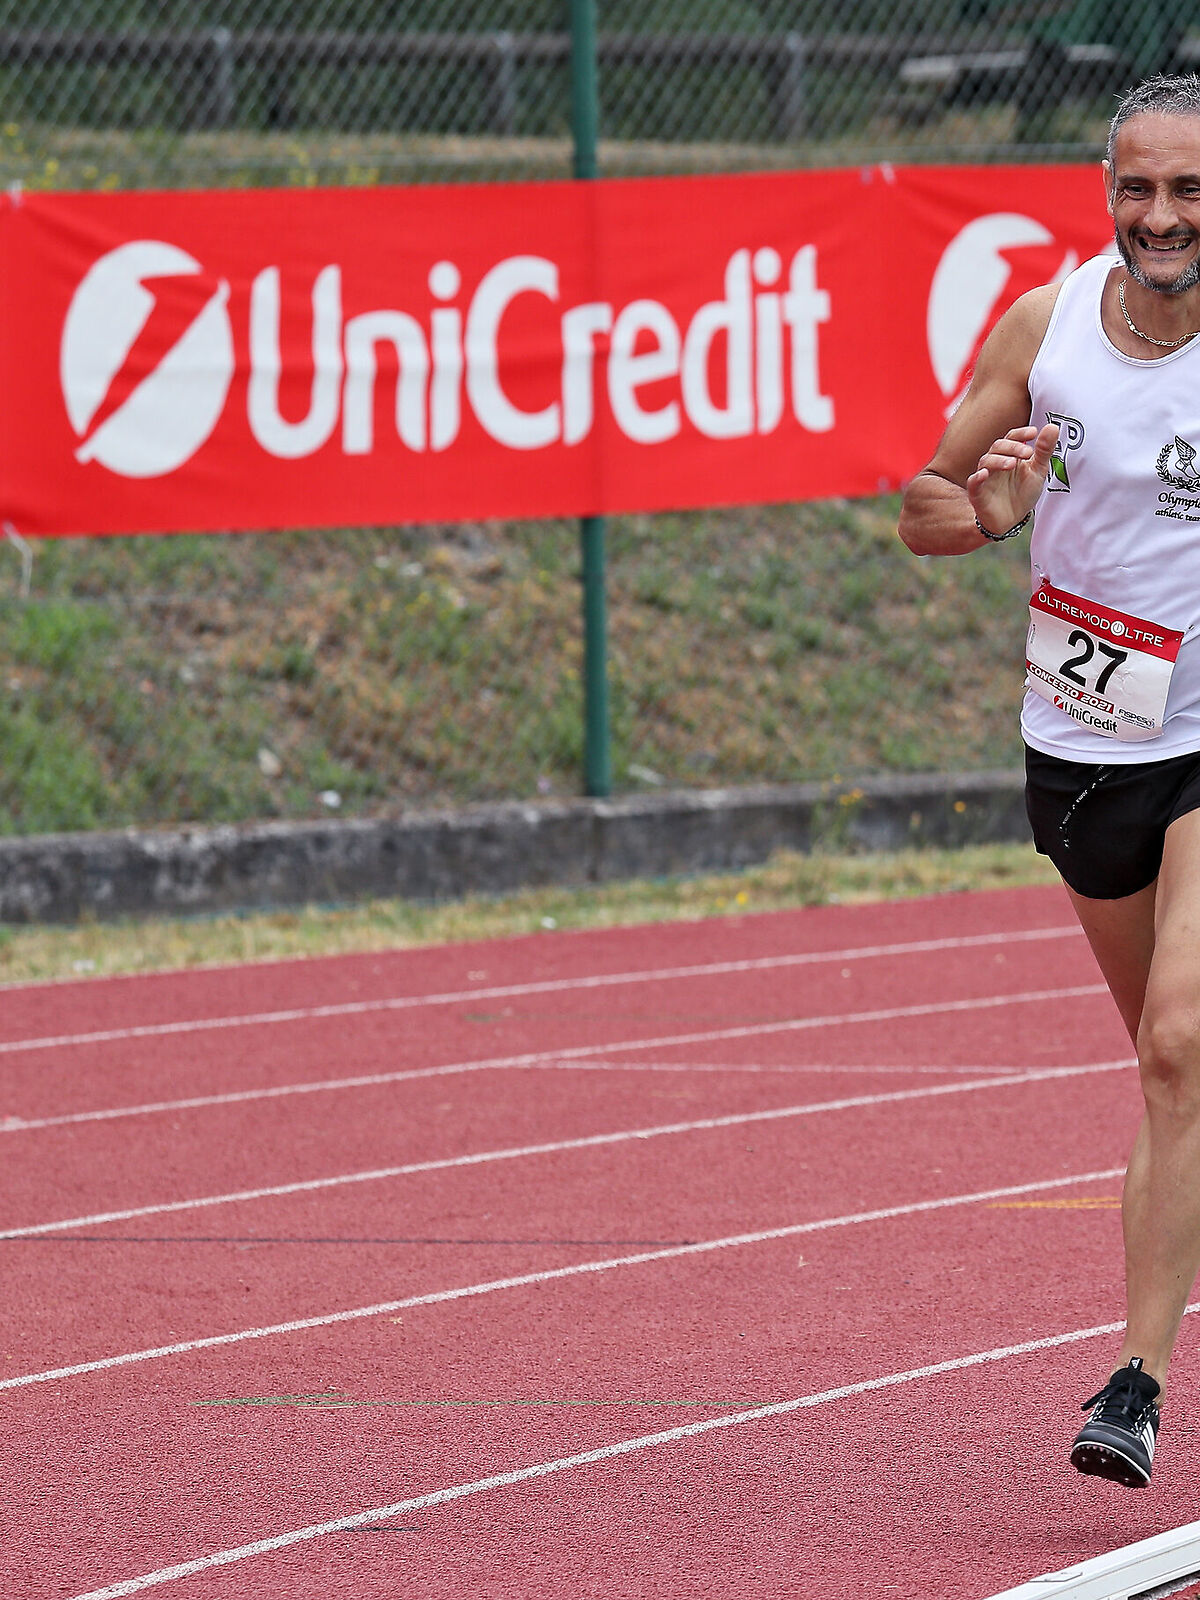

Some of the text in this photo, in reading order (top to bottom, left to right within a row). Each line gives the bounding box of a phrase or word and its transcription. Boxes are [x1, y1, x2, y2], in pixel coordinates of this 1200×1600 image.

[247, 244, 836, 460] UniCredit
[1155, 508, 1184, 520] athletic
[1058, 629, 1129, 695] 27
[1029, 664, 1113, 713] CONCESIO 2021
[1064, 701, 1119, 733] UniCredit
